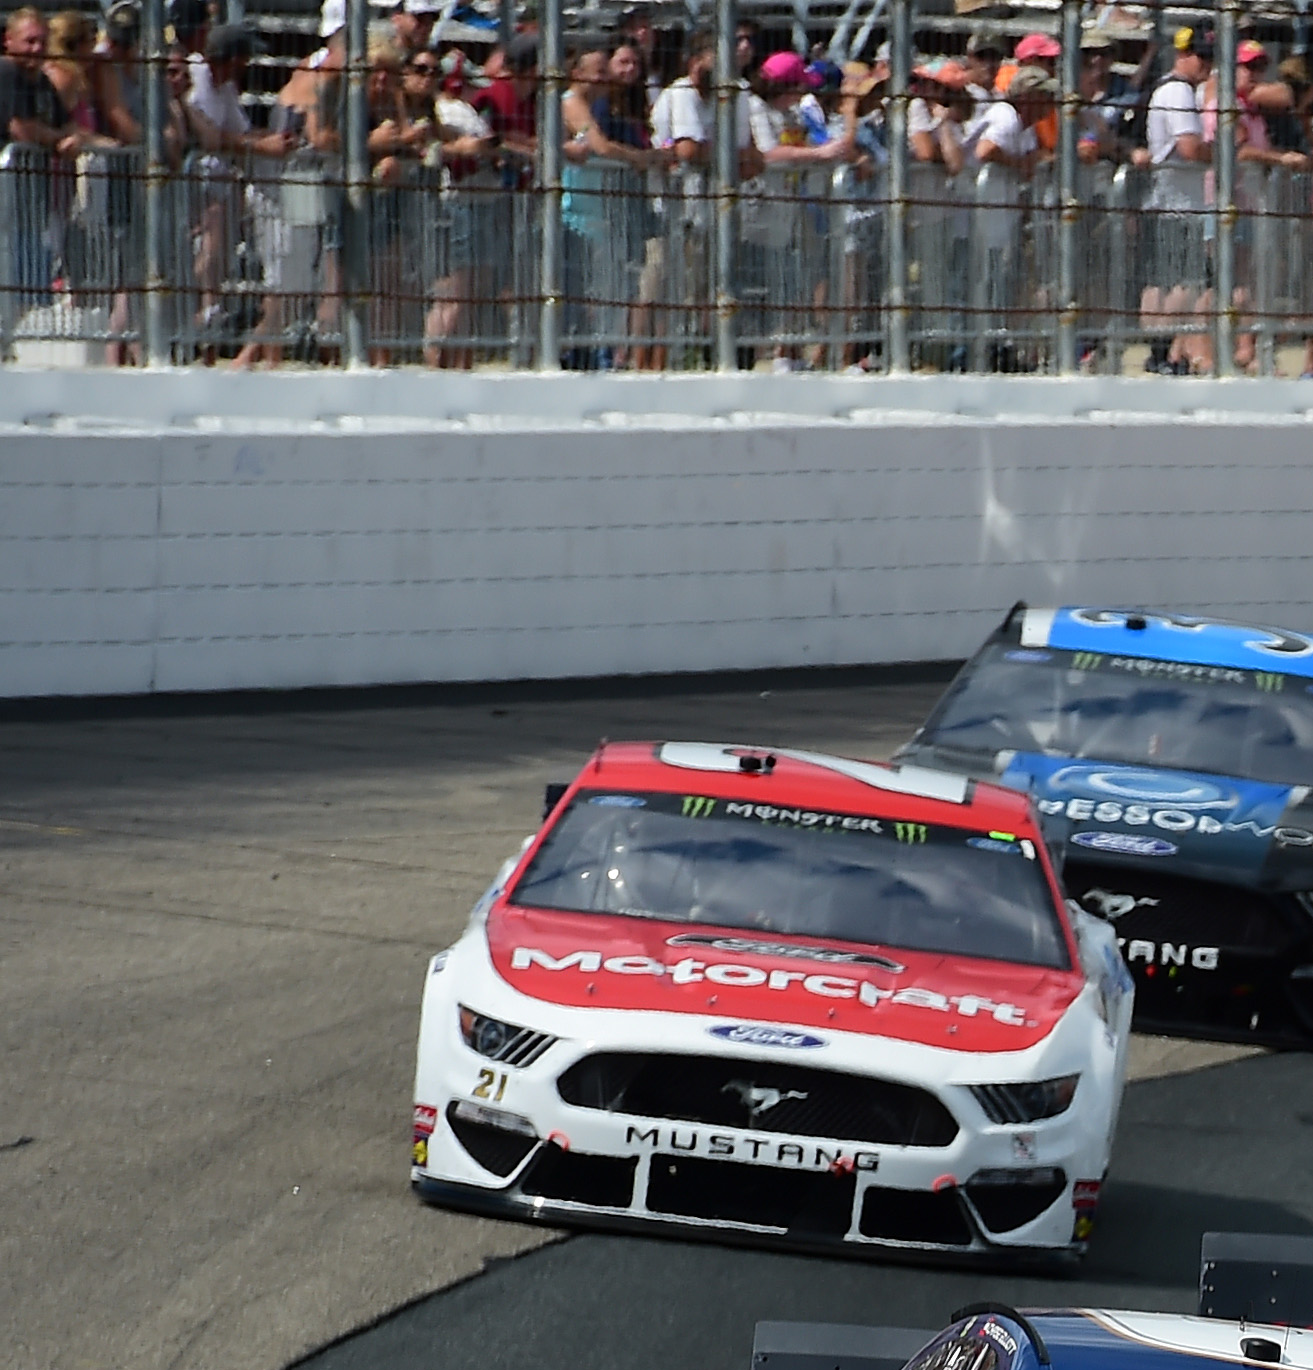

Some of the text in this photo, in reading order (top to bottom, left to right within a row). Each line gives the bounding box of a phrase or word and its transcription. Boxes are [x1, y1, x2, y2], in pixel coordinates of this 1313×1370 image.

[726, 800, 884, 834] MONSTER
[510, 945, 1030, 1026] Motorcraft
[471, 1067, 508, 1102] 21
[626, 1123, 880, 1174] MUSTANG
